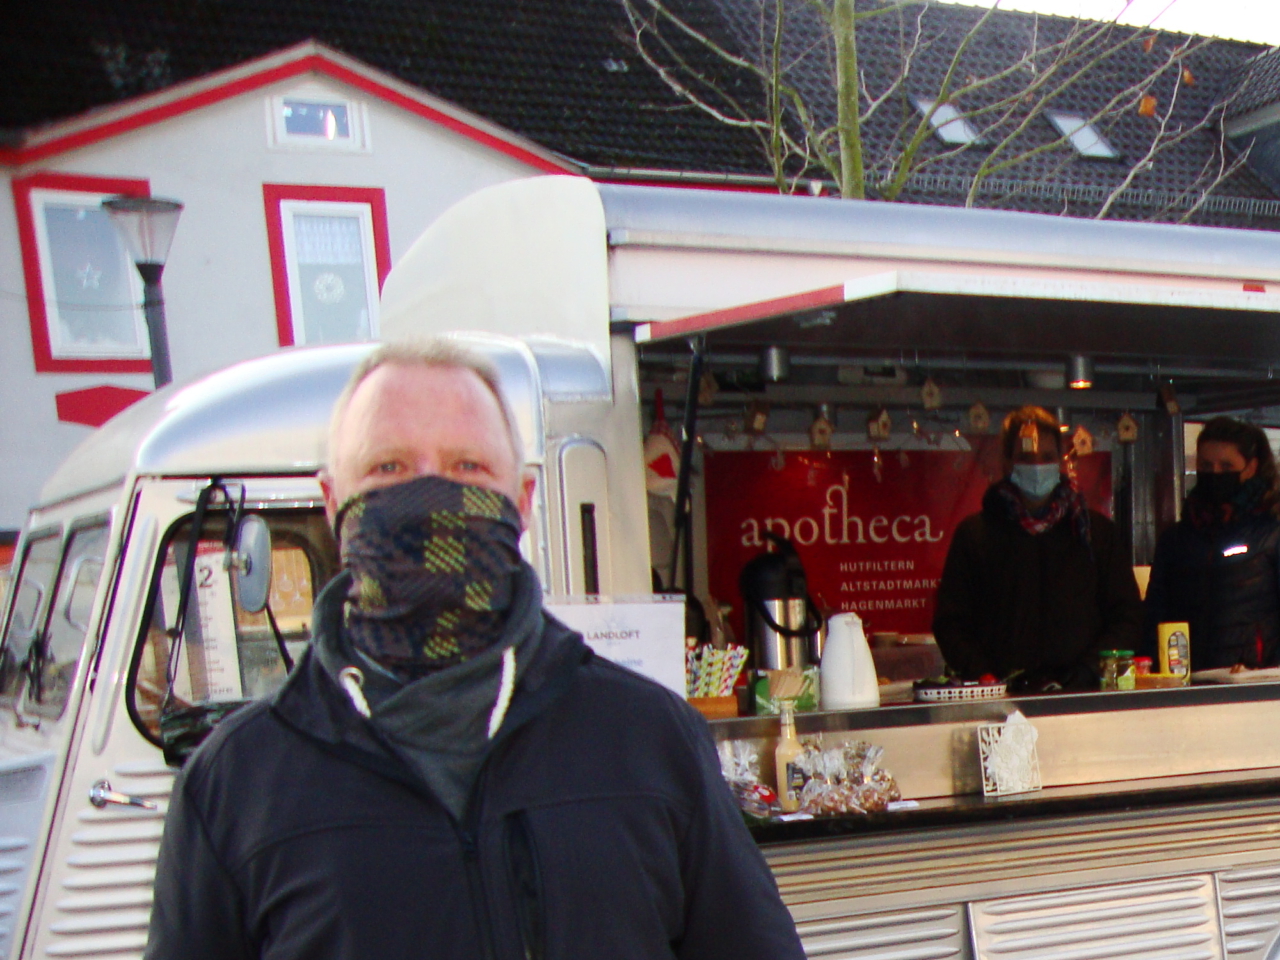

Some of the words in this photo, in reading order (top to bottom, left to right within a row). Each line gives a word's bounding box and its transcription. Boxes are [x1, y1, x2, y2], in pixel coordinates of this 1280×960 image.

[740, 484, 944, 553] apotheca
[840, 560, 915, 572] HUTFILTERN
[841, 598, 927, 611] HAGENMARKT
[586, 630, 641, 641] LANDLOFT
